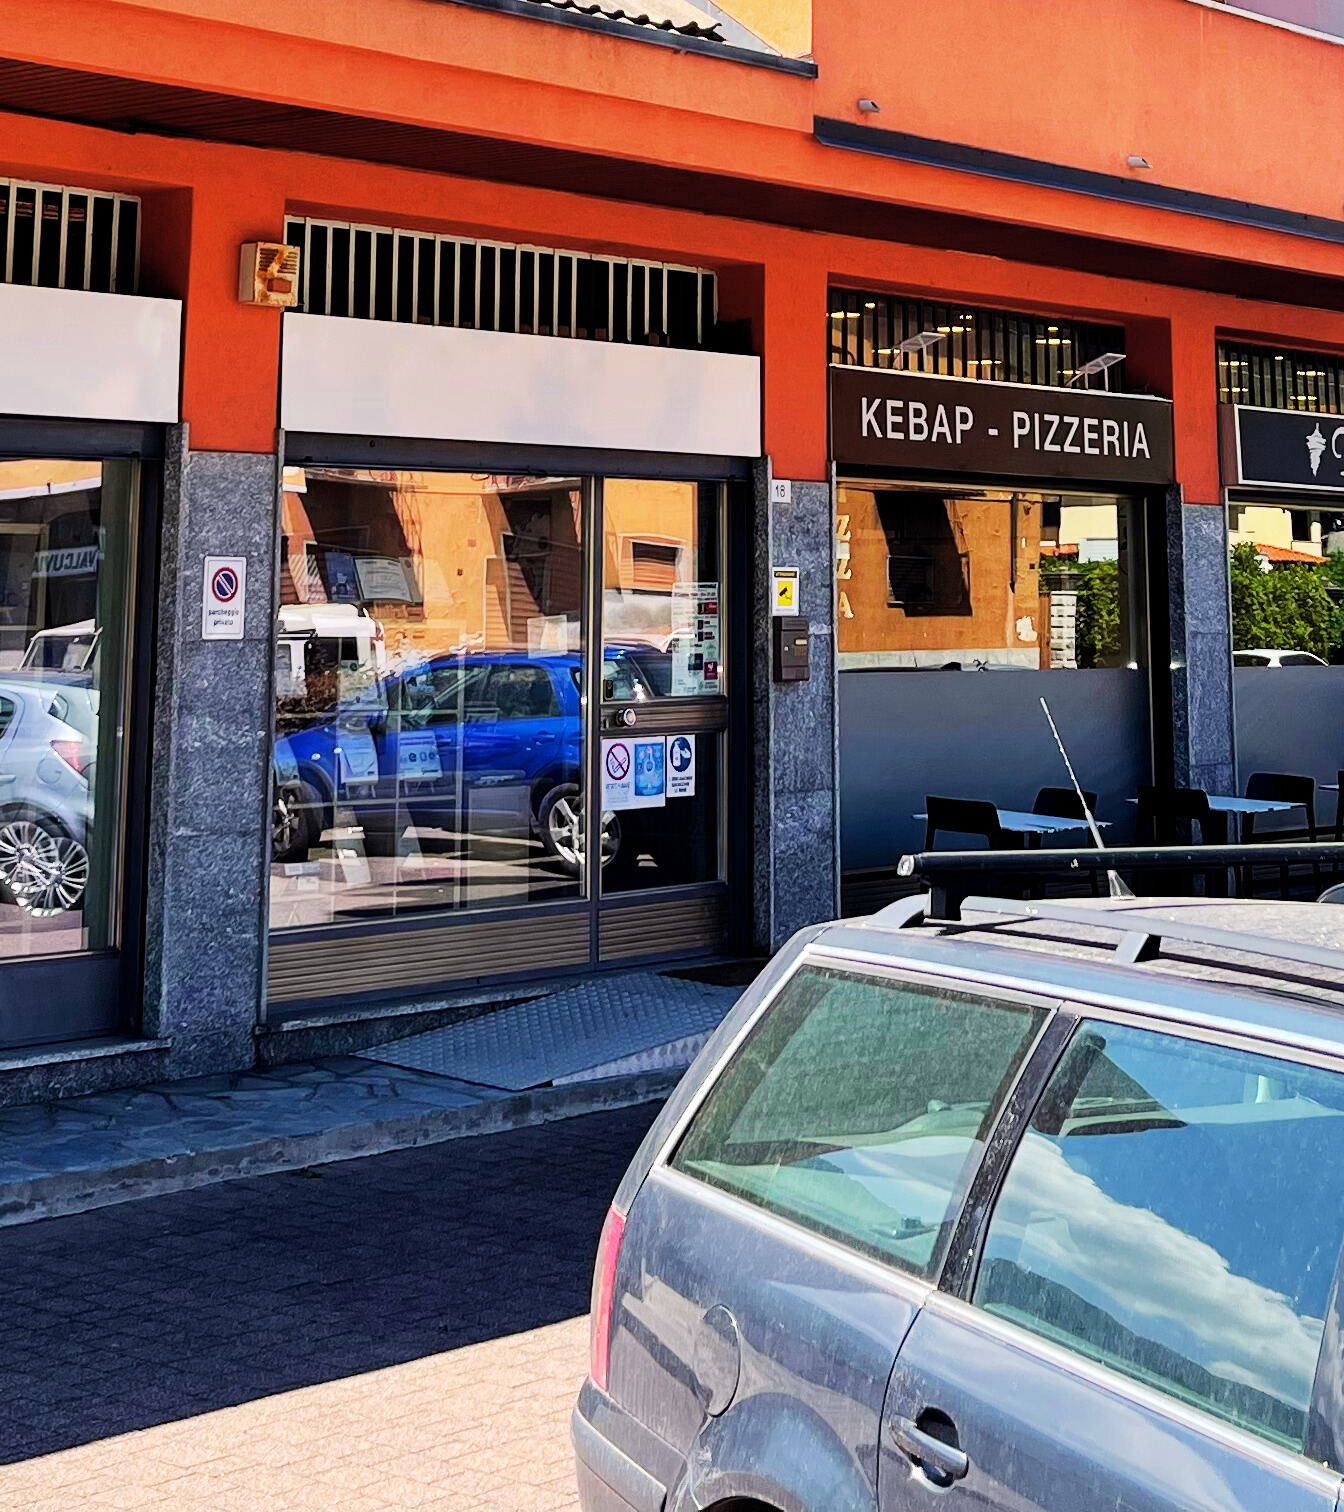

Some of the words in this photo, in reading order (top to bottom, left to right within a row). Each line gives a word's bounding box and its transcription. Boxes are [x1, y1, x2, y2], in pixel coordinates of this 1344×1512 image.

[861, 396, 974, 445] KEBAP
[1012, 410, 1151, 459] PIZZERIA
[774, 484, 786, 499] 18
[208, 608, 240, 617] parcheggio
